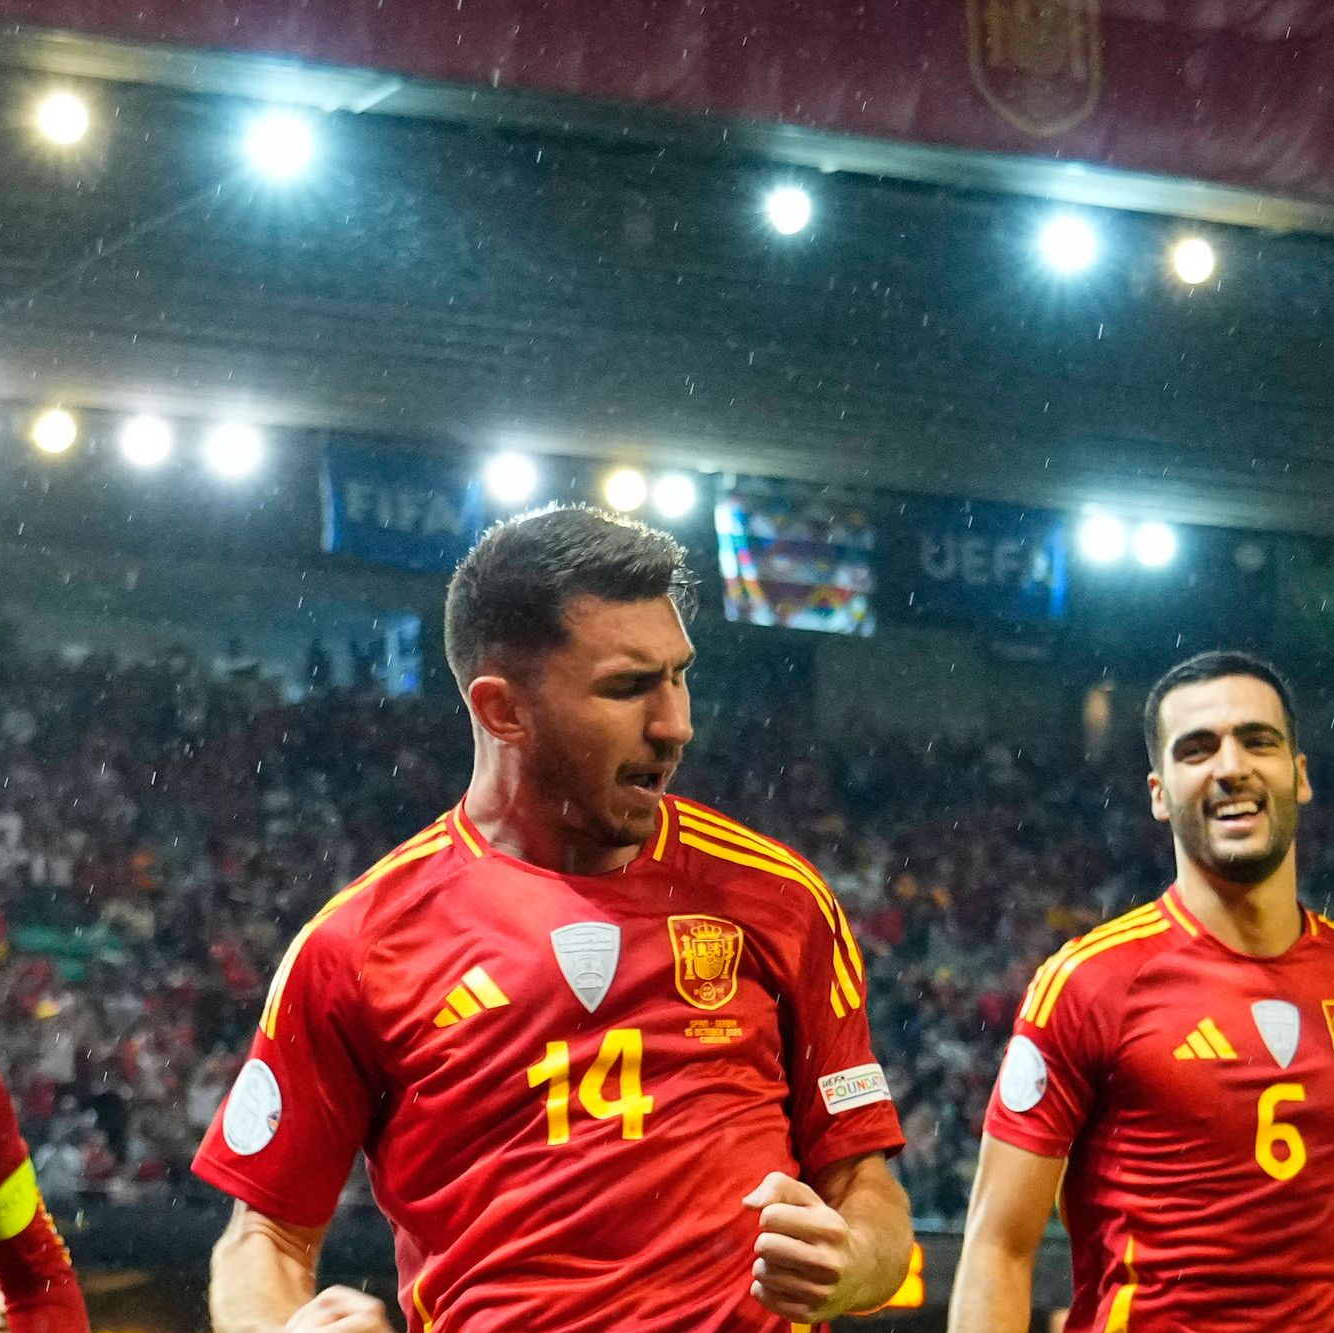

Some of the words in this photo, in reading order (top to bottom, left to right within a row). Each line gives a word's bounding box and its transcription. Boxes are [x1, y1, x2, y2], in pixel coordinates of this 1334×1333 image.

[344, 478, 464, 537] FIFA
[919, 528, 1055, 588] UEFA
[526, 1028, 655, 1146] 14
[822, 1075, 845, 1088] UEFA
[1254, 1082, 1308, 1181] 6
